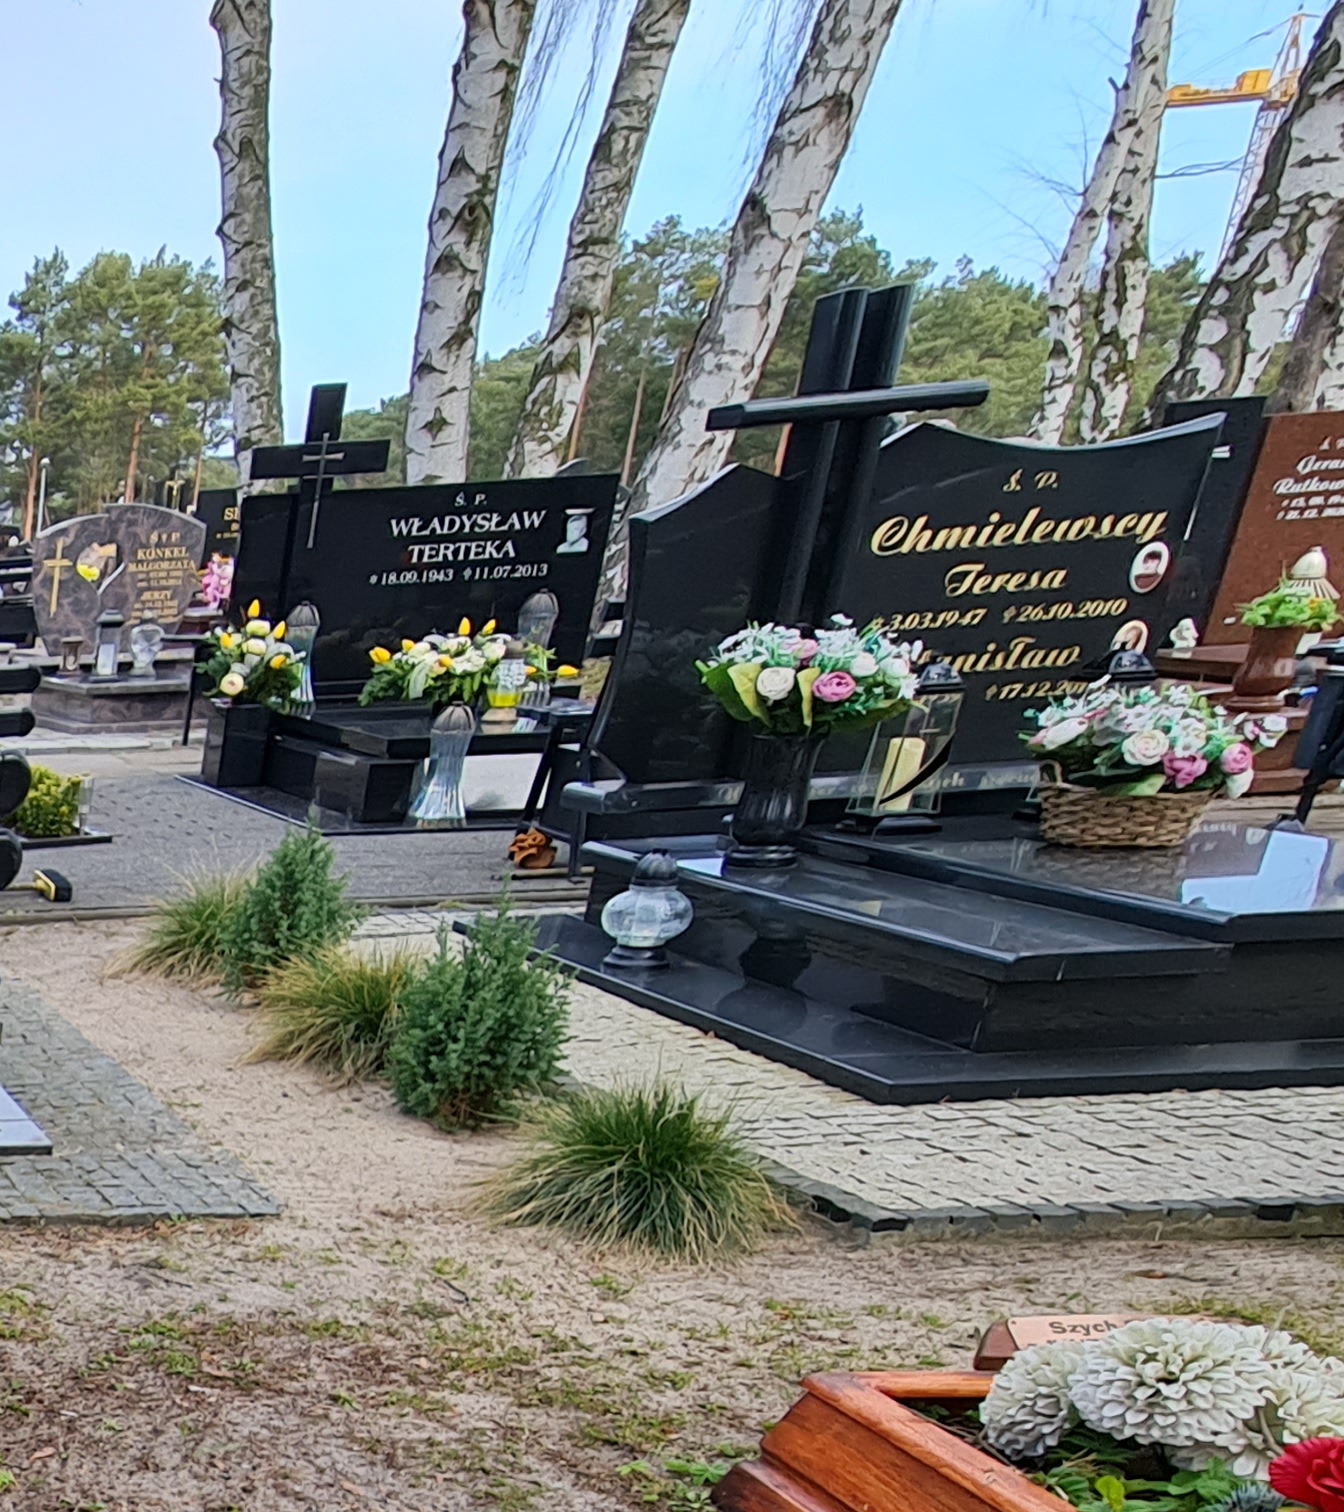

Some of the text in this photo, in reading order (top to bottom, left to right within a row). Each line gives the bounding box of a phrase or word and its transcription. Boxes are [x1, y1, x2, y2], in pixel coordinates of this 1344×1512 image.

[1273, 476, 1344, 495] Rutkow
[390, 510, 547, 538] WŁADYSŁAW
[869, 506, 1169, 557] Chmielewscy
[407, 539, 515, 564] TERTEKA
[380, 563, 548, 586] 18.09.1943 11.07.2013
[944, 563, 1069, 597] Teresa
[1048, 1320, 1118, 1337] Szych
